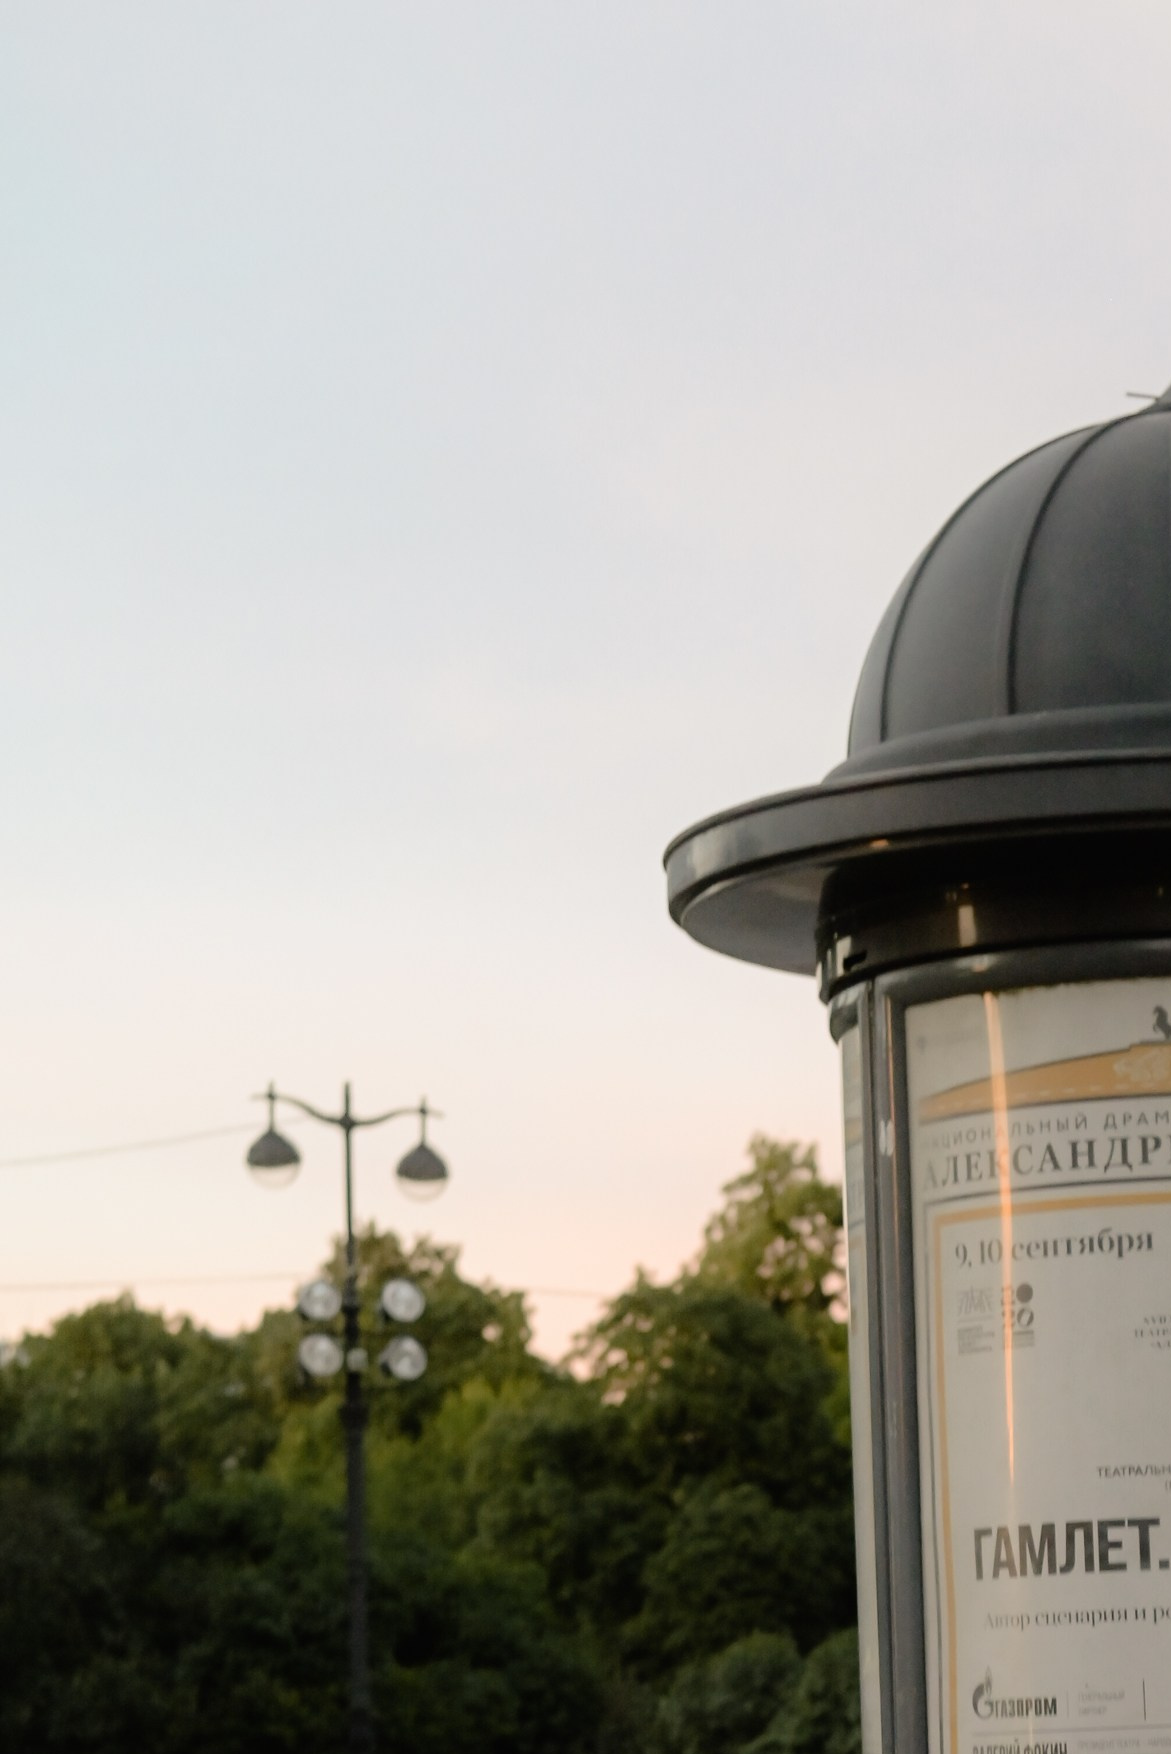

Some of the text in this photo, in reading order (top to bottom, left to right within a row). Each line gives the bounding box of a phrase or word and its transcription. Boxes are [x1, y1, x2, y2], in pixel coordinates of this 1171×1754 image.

[979, 1238, 1003, 1265] 10
[1012, 1227, 1154, 1261] сентября
[973, 1516, 1171, 1581] ГАМЛЕТ.
[1035, 1607, 1128, 1628] сценария
[1133, 1607, 1147, 1621] и
[994, 1696, 1058, 1720] ГАЗПРОМ
